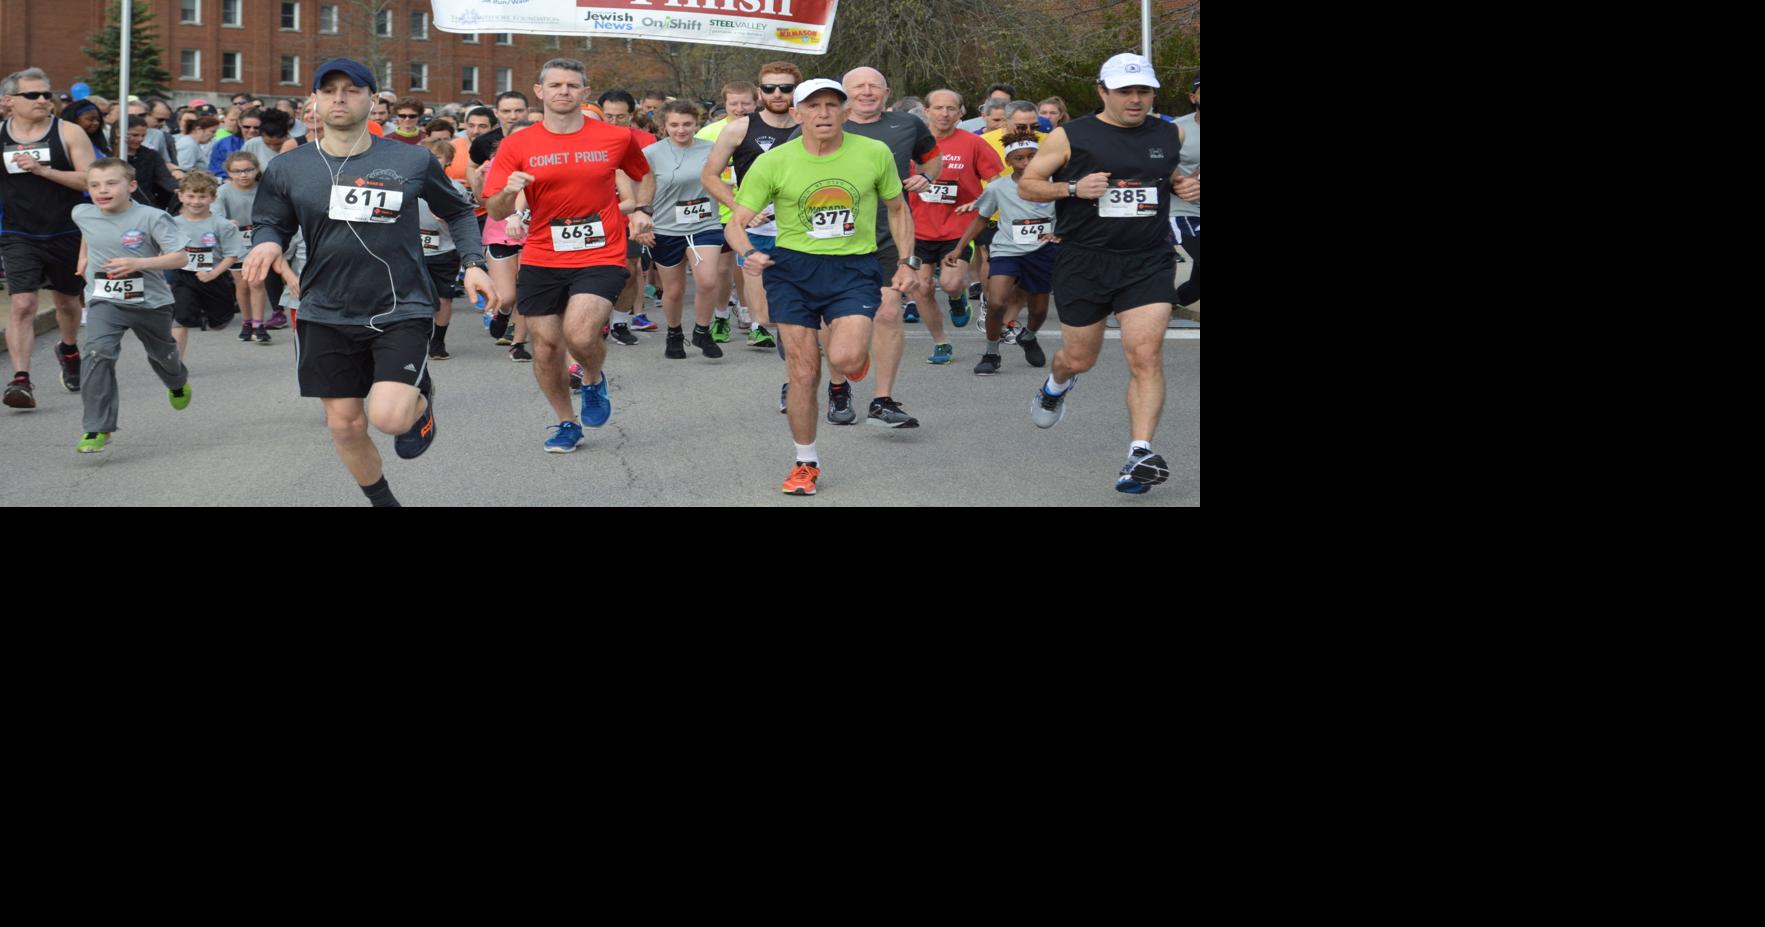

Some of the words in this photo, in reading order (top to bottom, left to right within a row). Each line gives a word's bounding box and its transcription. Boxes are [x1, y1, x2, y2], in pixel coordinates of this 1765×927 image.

[584, 11, 633, 22] Jewish
[594, 20, 633, 31] News
[529, 152, 570, 168] COMET
[574, 150, 609, 163] PRIDE
[344, 188, 387, 208] 611
[1109, 189, 1147, 204] 385
[683, 204, 706, 216] 644
[814, 209, 851, 226] 377
[561, 224, 594, 240] 663
[1020, 224, 1045, 236] 649
[104, 280, 133, 293] 645
